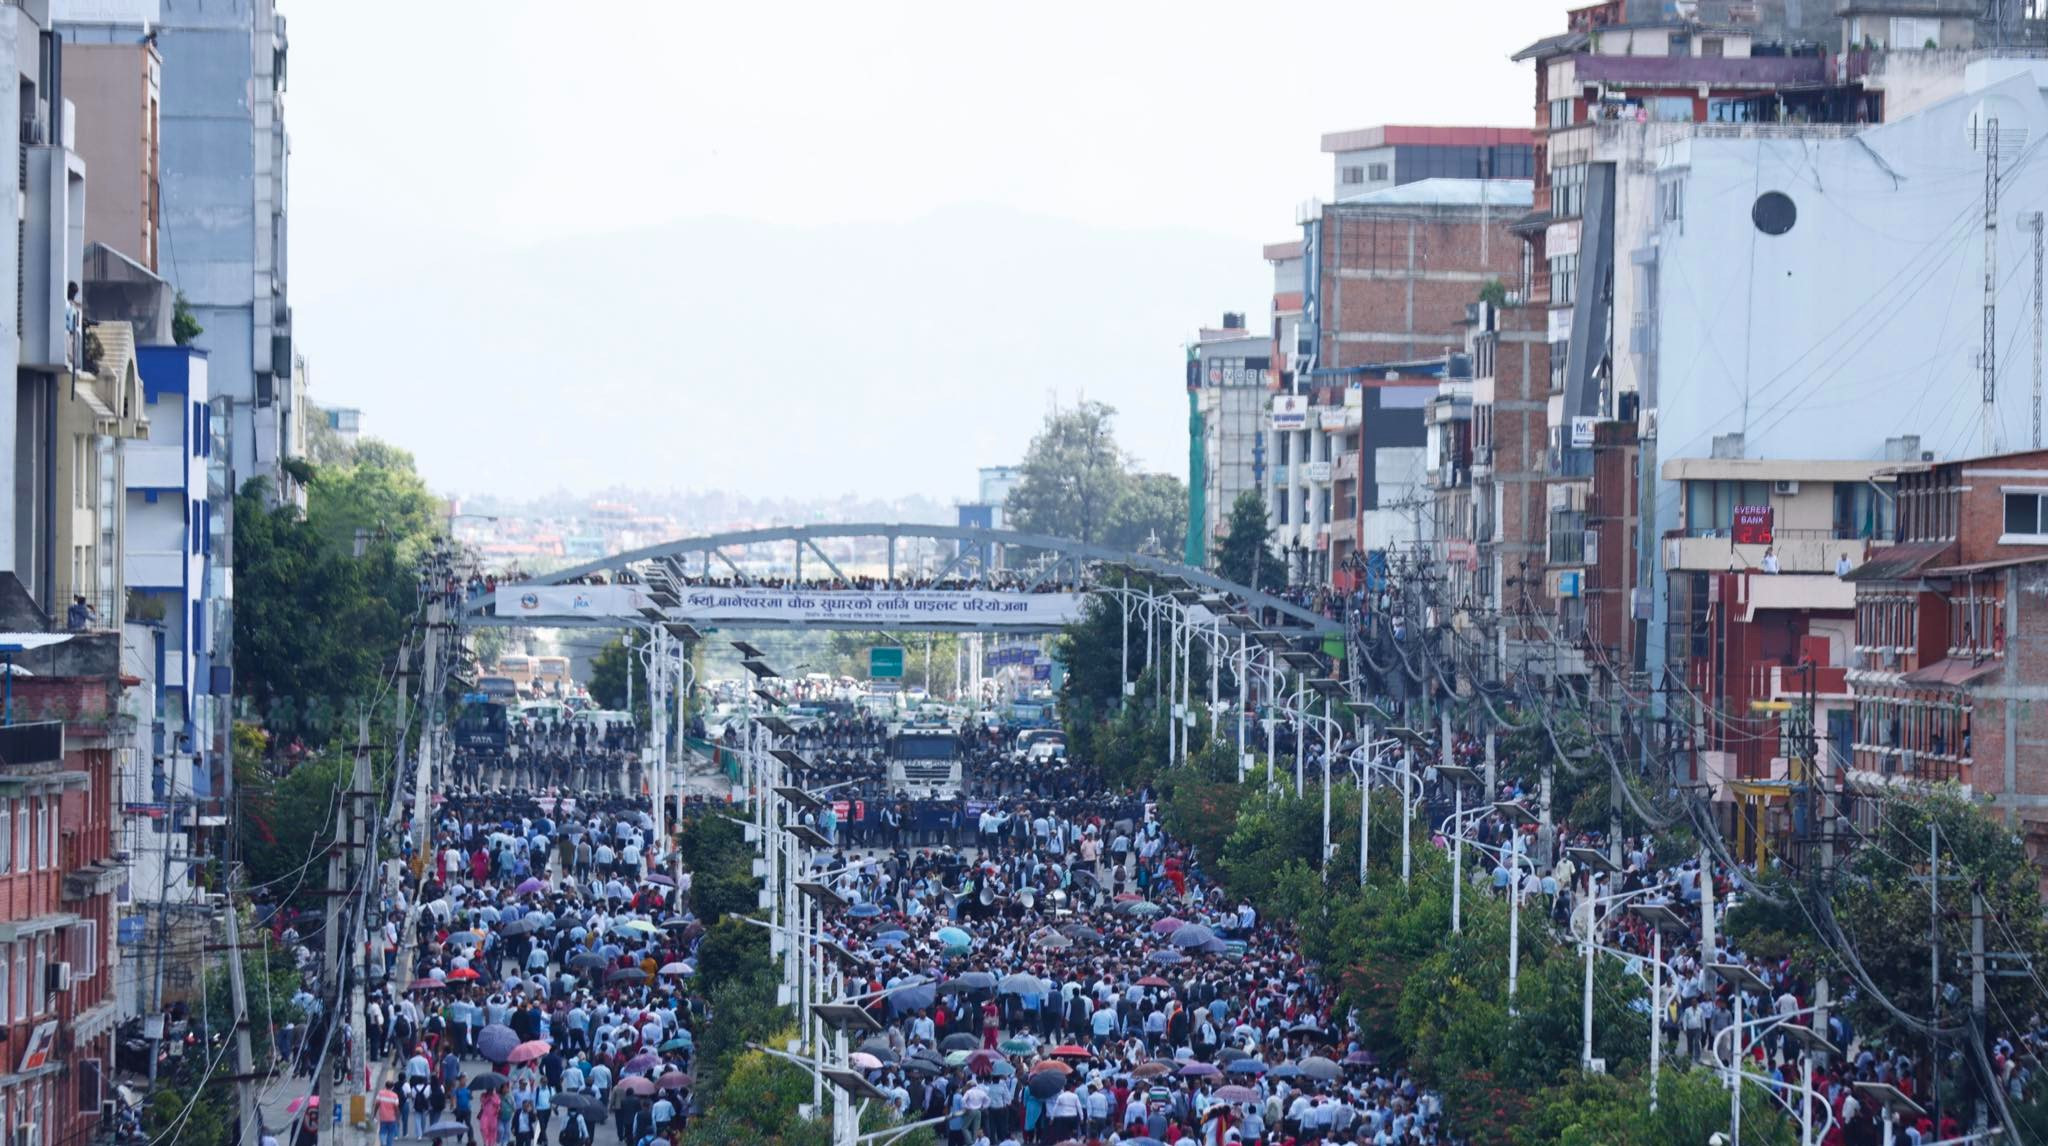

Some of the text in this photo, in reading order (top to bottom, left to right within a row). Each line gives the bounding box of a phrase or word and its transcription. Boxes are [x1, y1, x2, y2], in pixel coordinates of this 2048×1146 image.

[1734, 506, 1771, 515] EVEREST
[1741, 516, 1764, 525] BANK
[820, 598, 872, 612] सुधारको
[877, 597, 910, 611] लागि
[913, 600, 958, 612] पाइलट
[963, 598, 1028, 612] परियोजना
[470, 736, 493, 744] TATA
